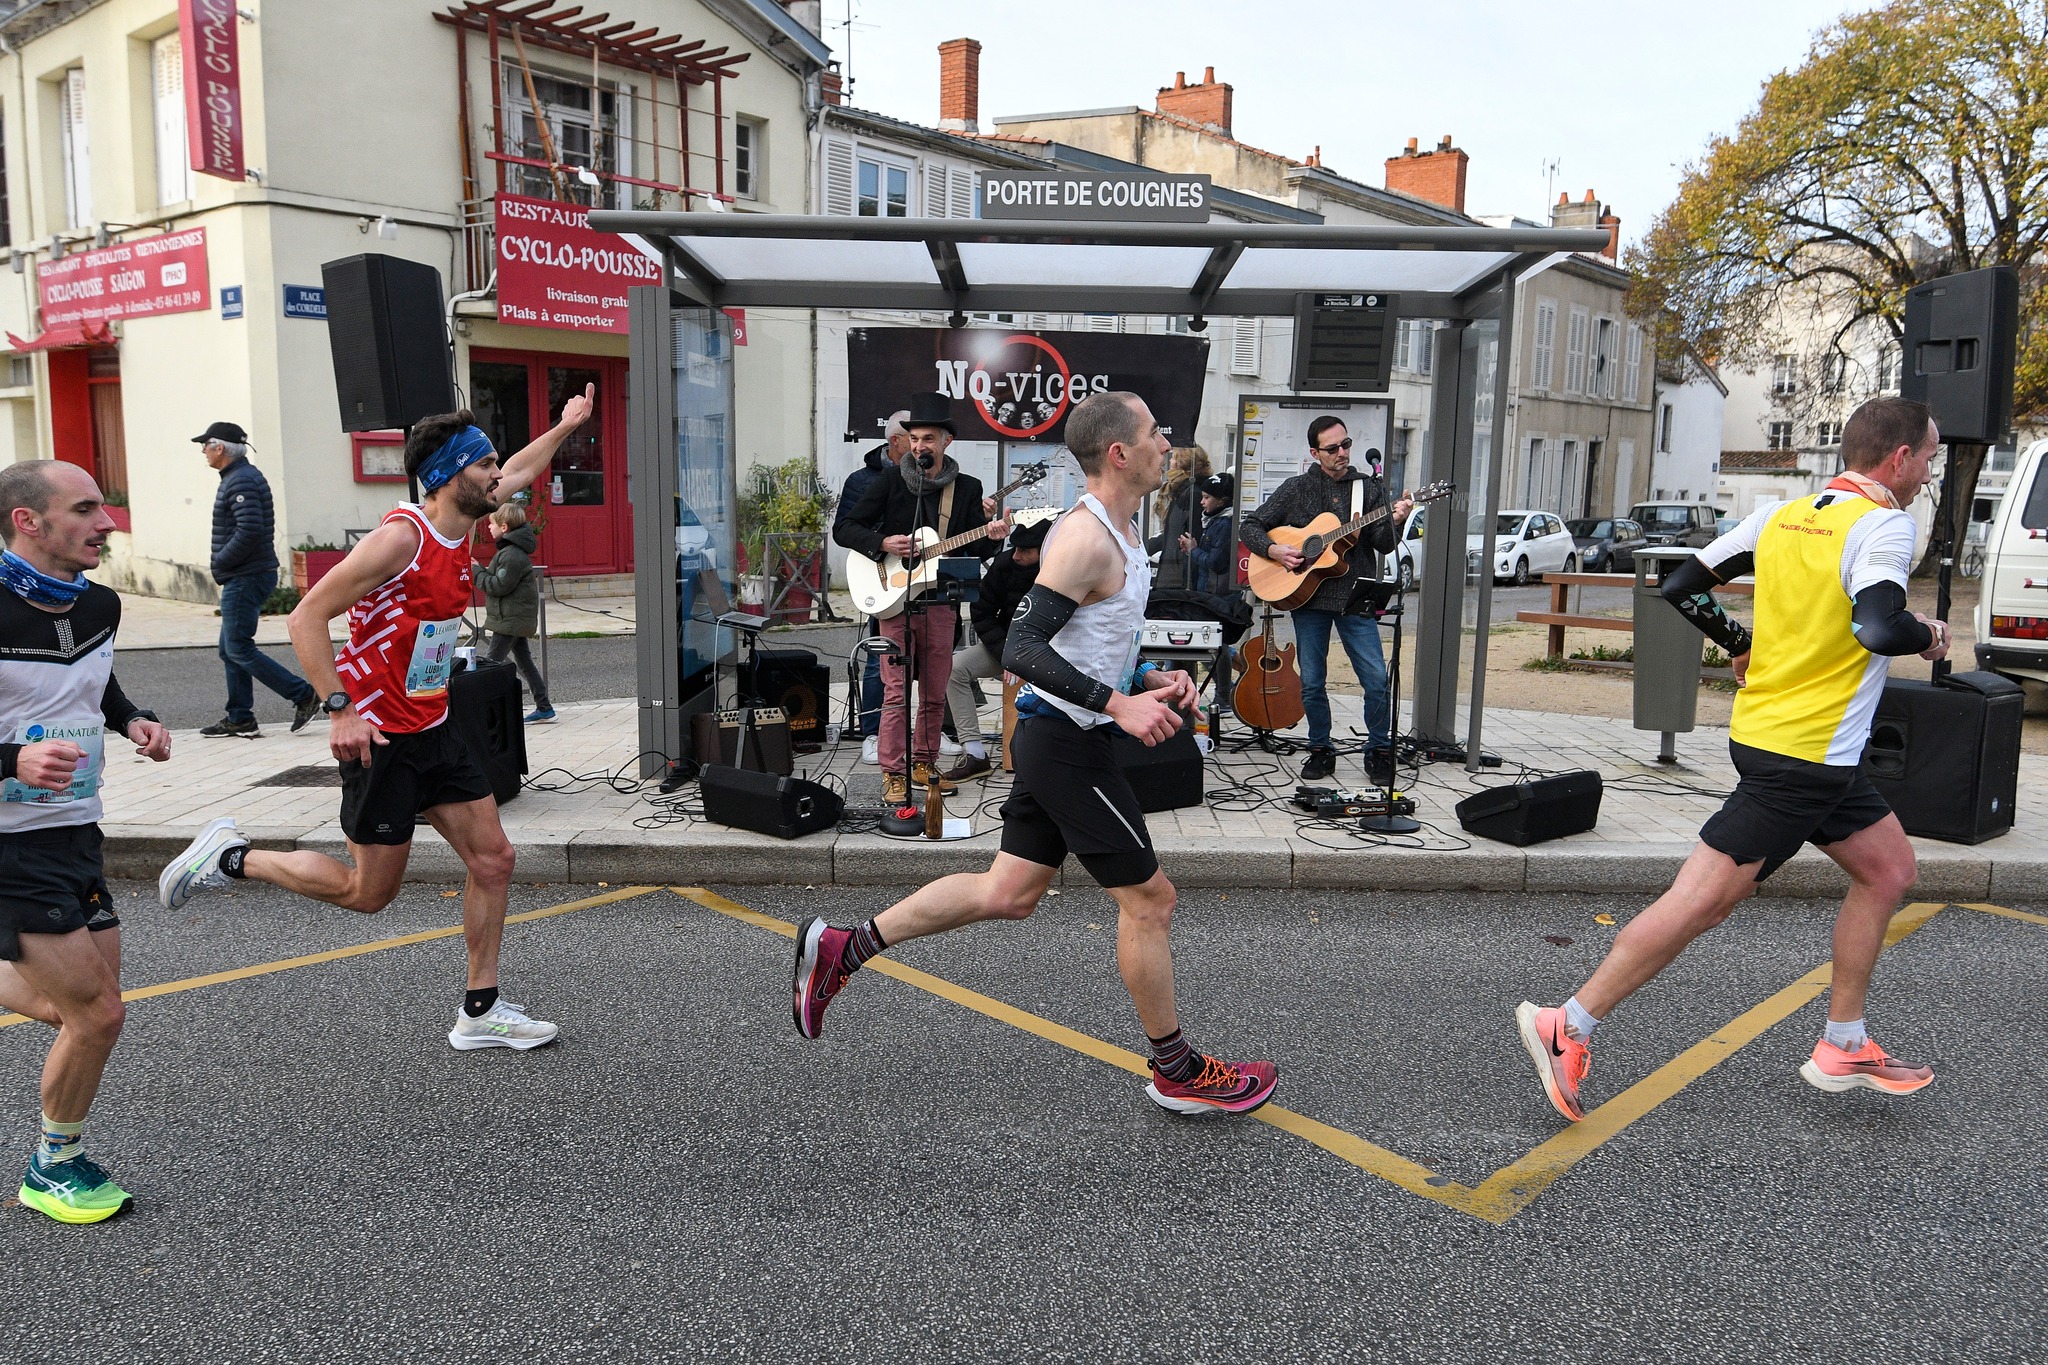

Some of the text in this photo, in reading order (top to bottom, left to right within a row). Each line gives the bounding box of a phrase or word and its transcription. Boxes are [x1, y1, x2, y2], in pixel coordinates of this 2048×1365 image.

[207, 80, 236, 173] POUSSE
[986, 179, 1204, 208] PORTE DE COUGNES
[501, 235, 659, 280] CYCLO-POUSSE
[47, 277, 104, 304] CYCLO-POUSSE
[300, 291, 321, 302] PLACE
[547, 287, 599, 305] livraison
[502, 304, 615, 328] Plats à emporter
[734, 328, 743, 340] 9
[935, 359, 1109, 405] No-vices
[45, 726, 99, 739] LÉA NATURE
